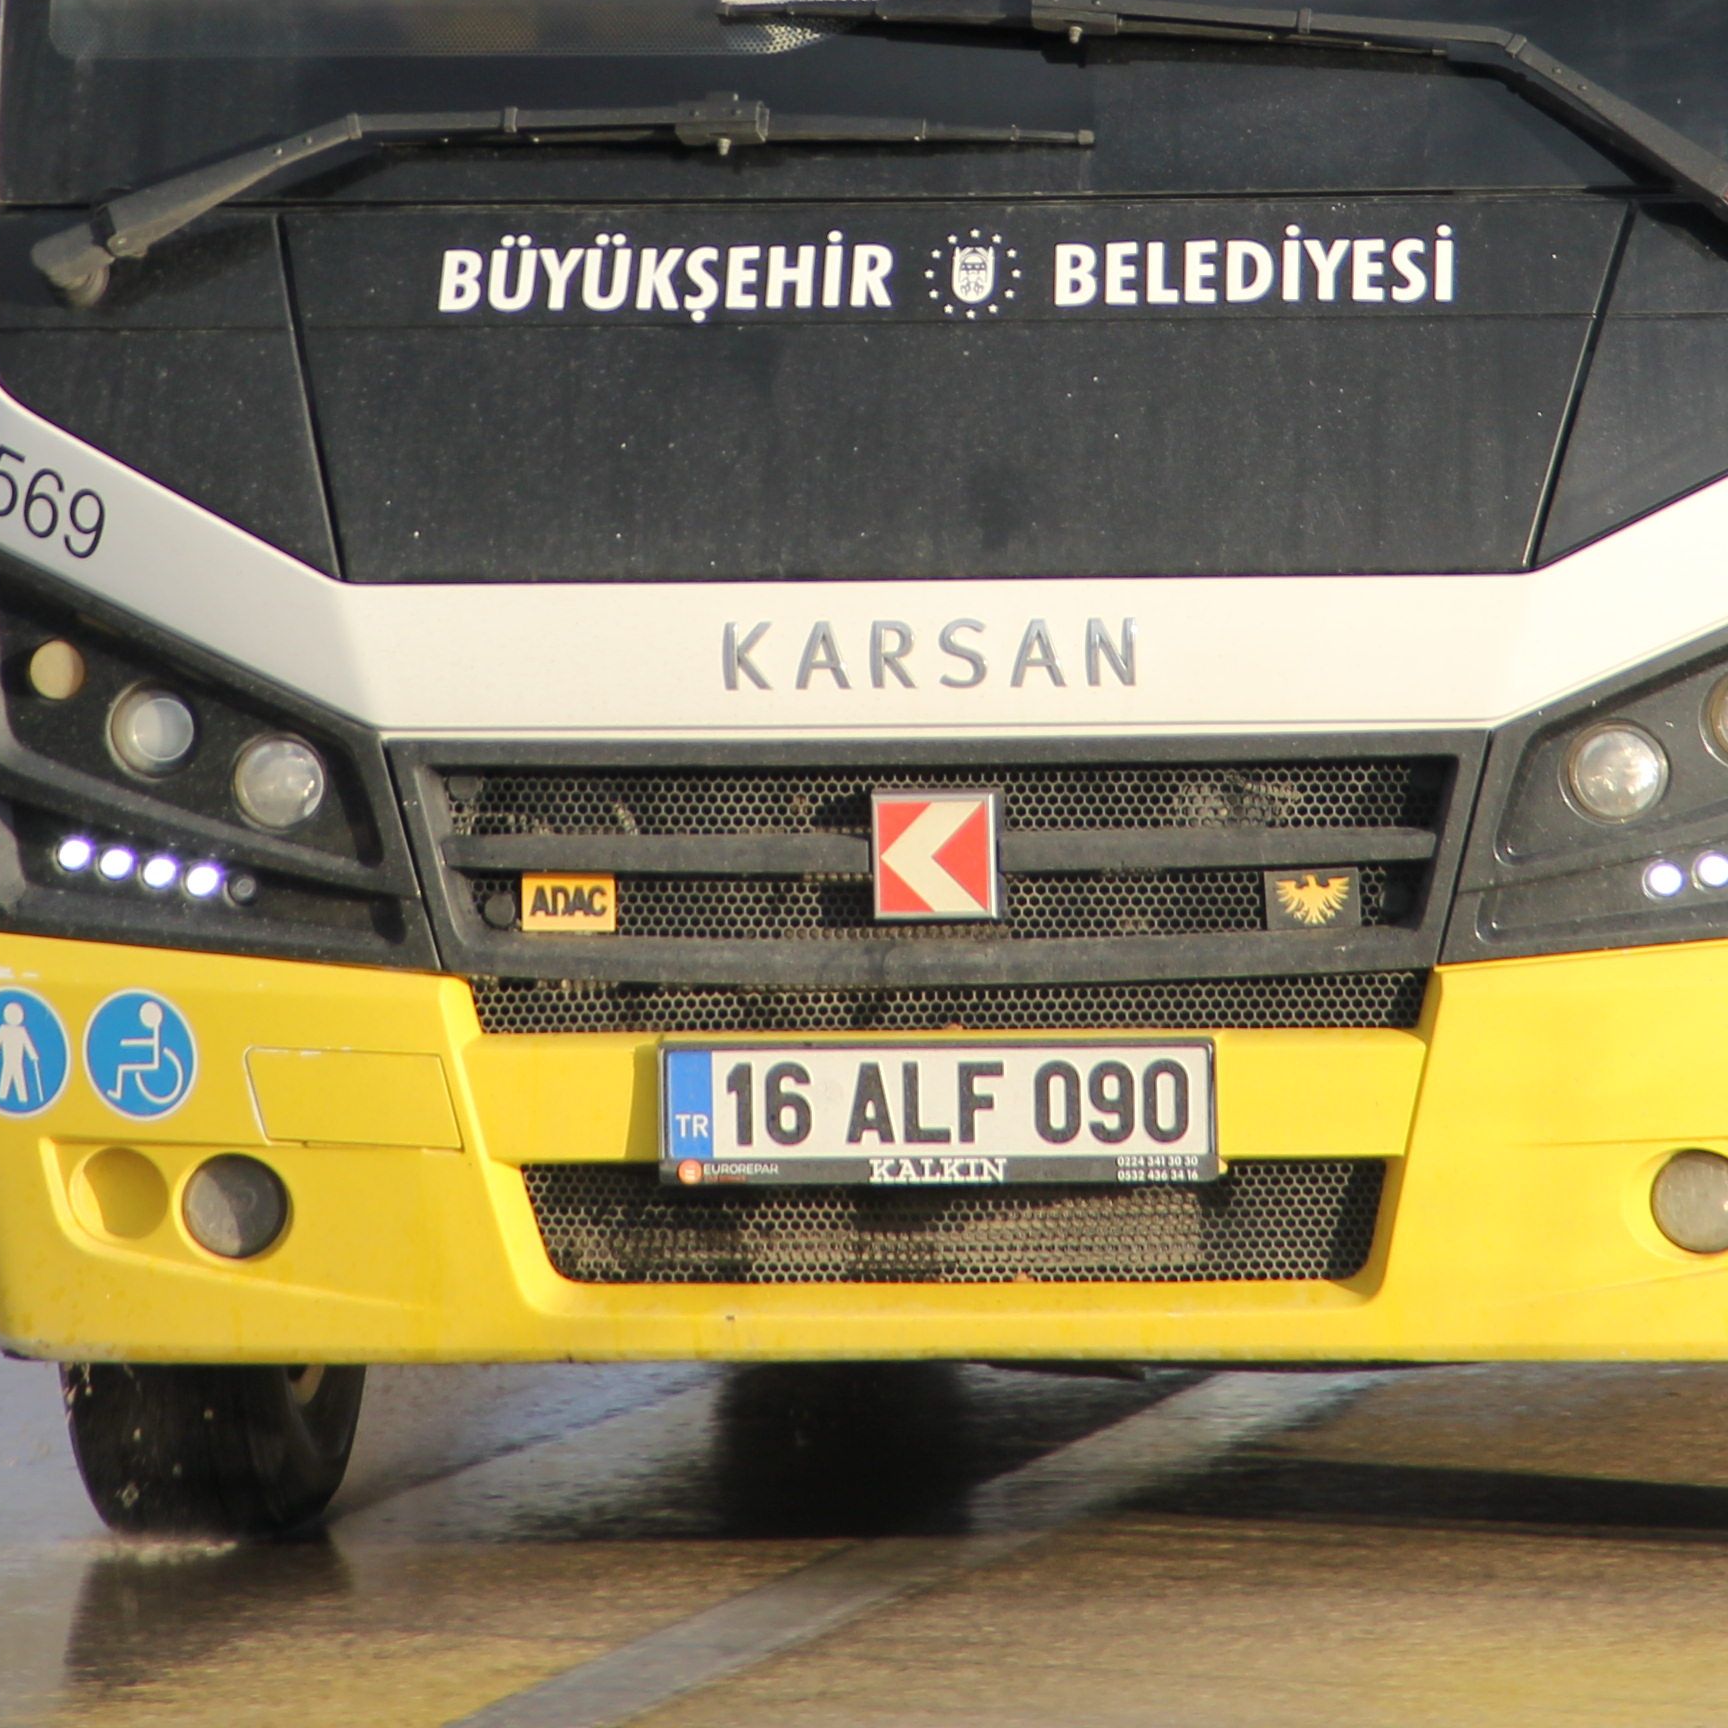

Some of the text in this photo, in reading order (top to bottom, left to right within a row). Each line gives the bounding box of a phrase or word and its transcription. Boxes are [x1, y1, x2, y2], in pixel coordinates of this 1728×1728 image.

[437, 224, 1456, 323] BÜYÜKŞEHİR BELEDİYESİ
[721, 617, 1138, 691] KARSAN
[529, 884, 608, 918] ADAC
[726, 1058, 1190, 1146] 16 ALF 090
[675, 1114, 709, 1139] TR
[703, 1162, 779, 1175] EUROREPAR
[868, 1158, 1008, 1183] KALKIN
[1117, 1156, 1199, 1167] 0224 341 30 30
[1117, 1169, 1199, 1181] 0532 436 34 16
